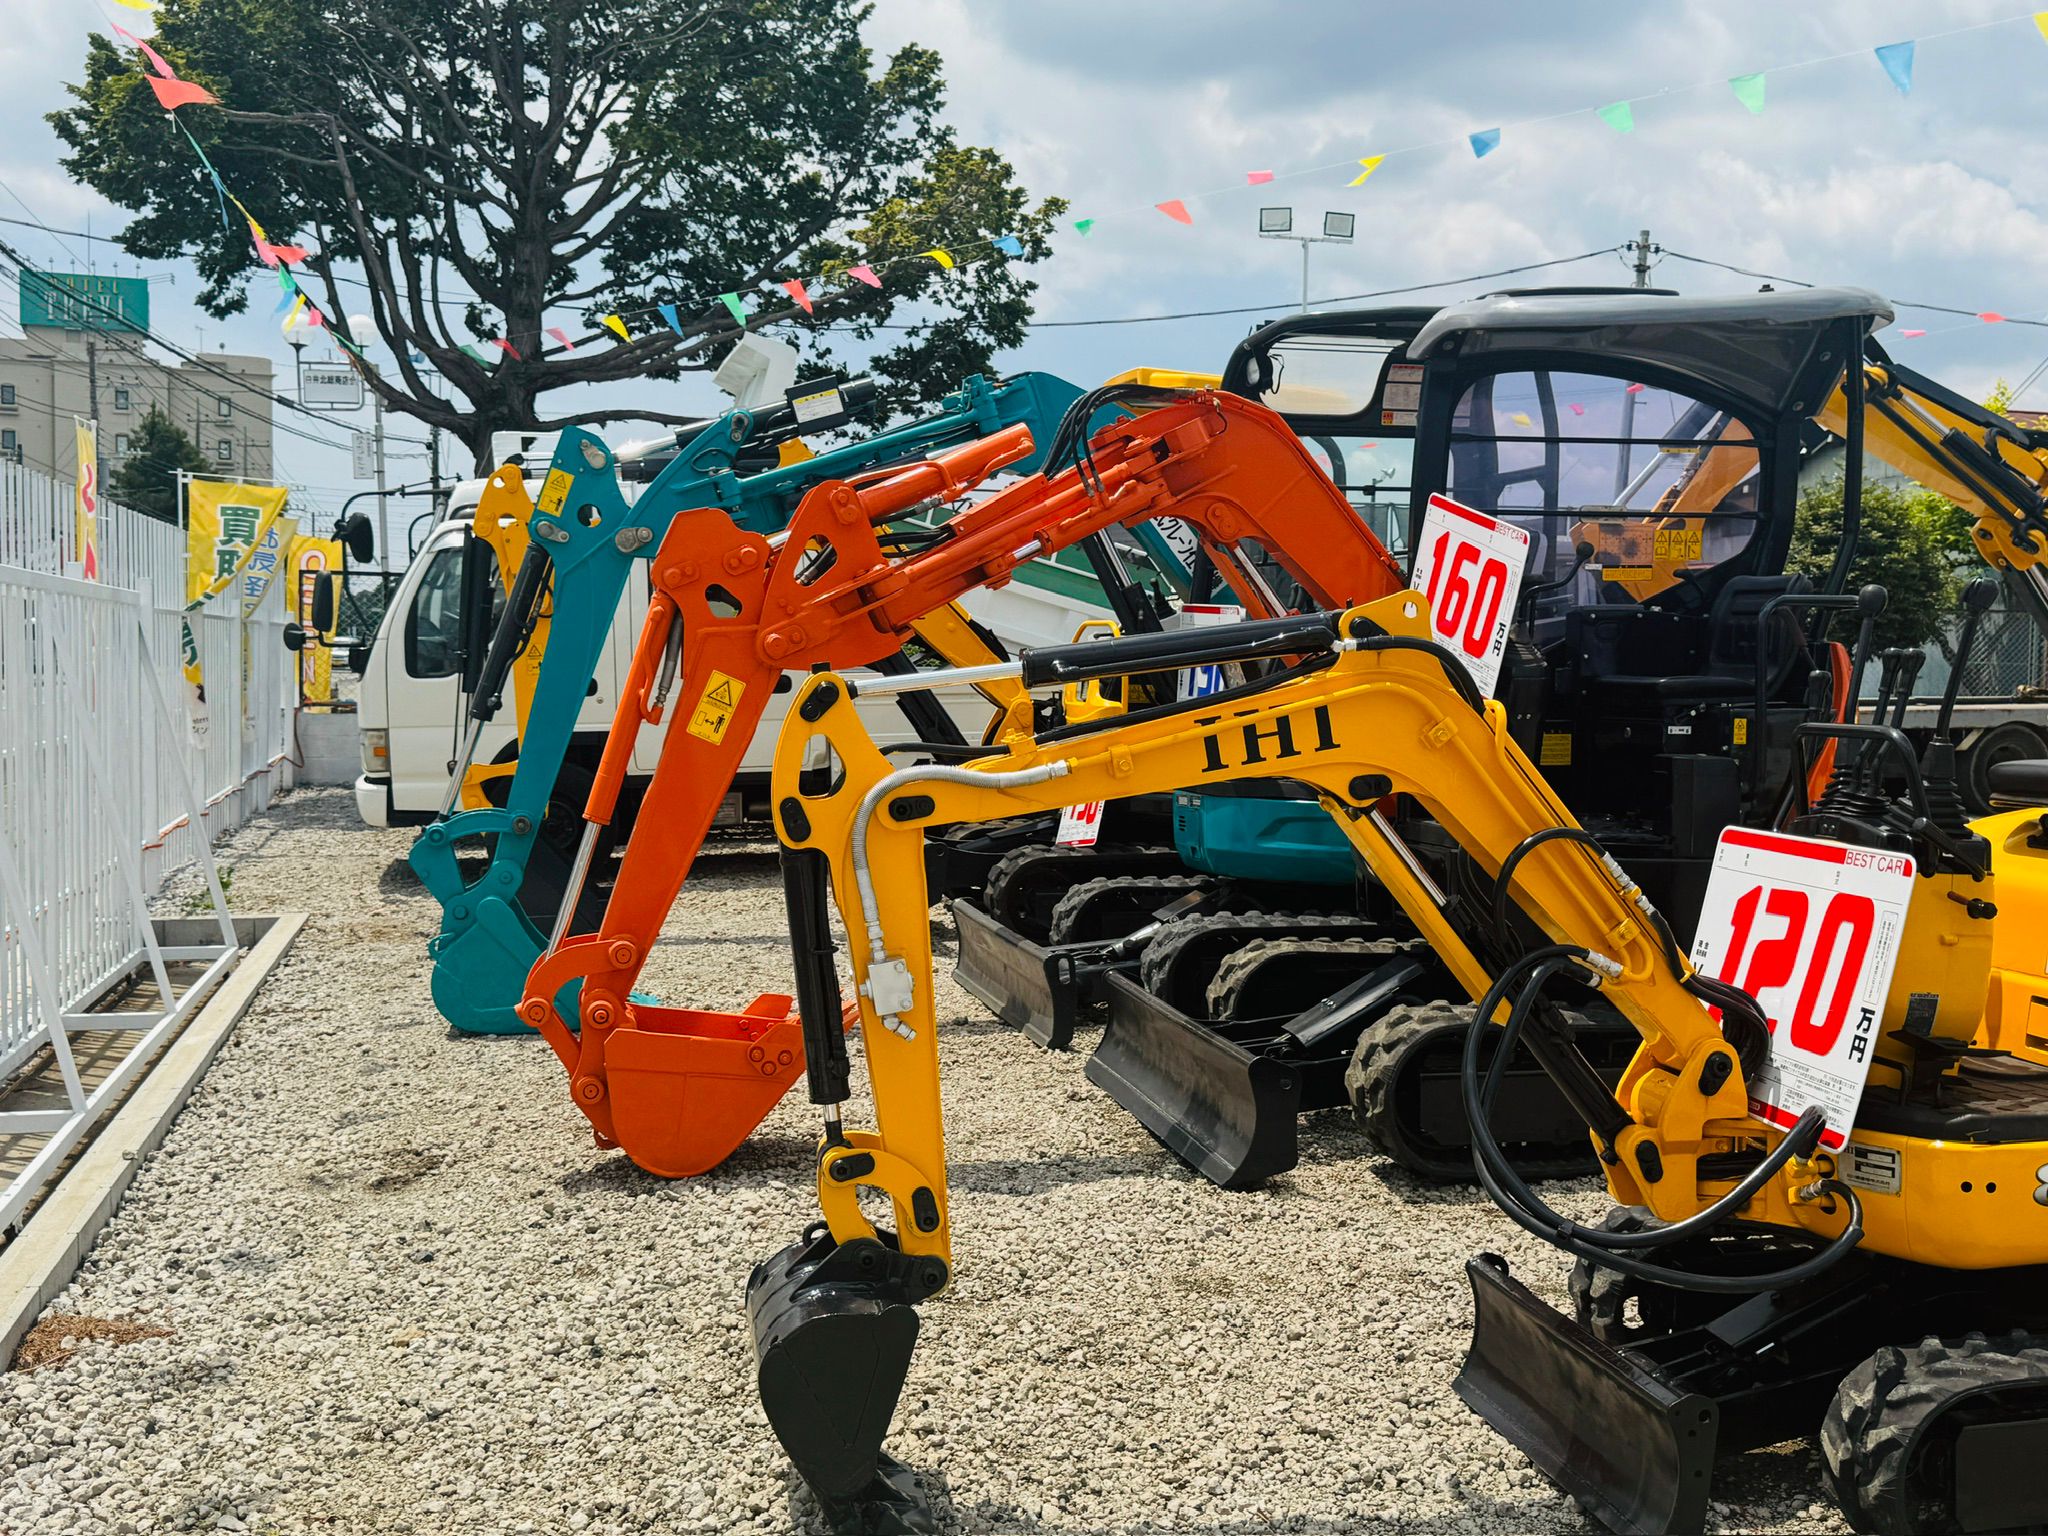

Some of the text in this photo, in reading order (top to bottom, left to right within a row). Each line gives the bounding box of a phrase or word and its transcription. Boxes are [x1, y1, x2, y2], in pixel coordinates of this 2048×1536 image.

[1153, 516, 1198, 570] クレーン仕
[1425, 531, 1508, 659] 160
[1194, 704, 1341, 773] IHI
[1845, 850, 1904, 875] BEST CAR
[1708, 884, 1875, 1058] 120
[1848, 1006, 1876, 1064] 万円
